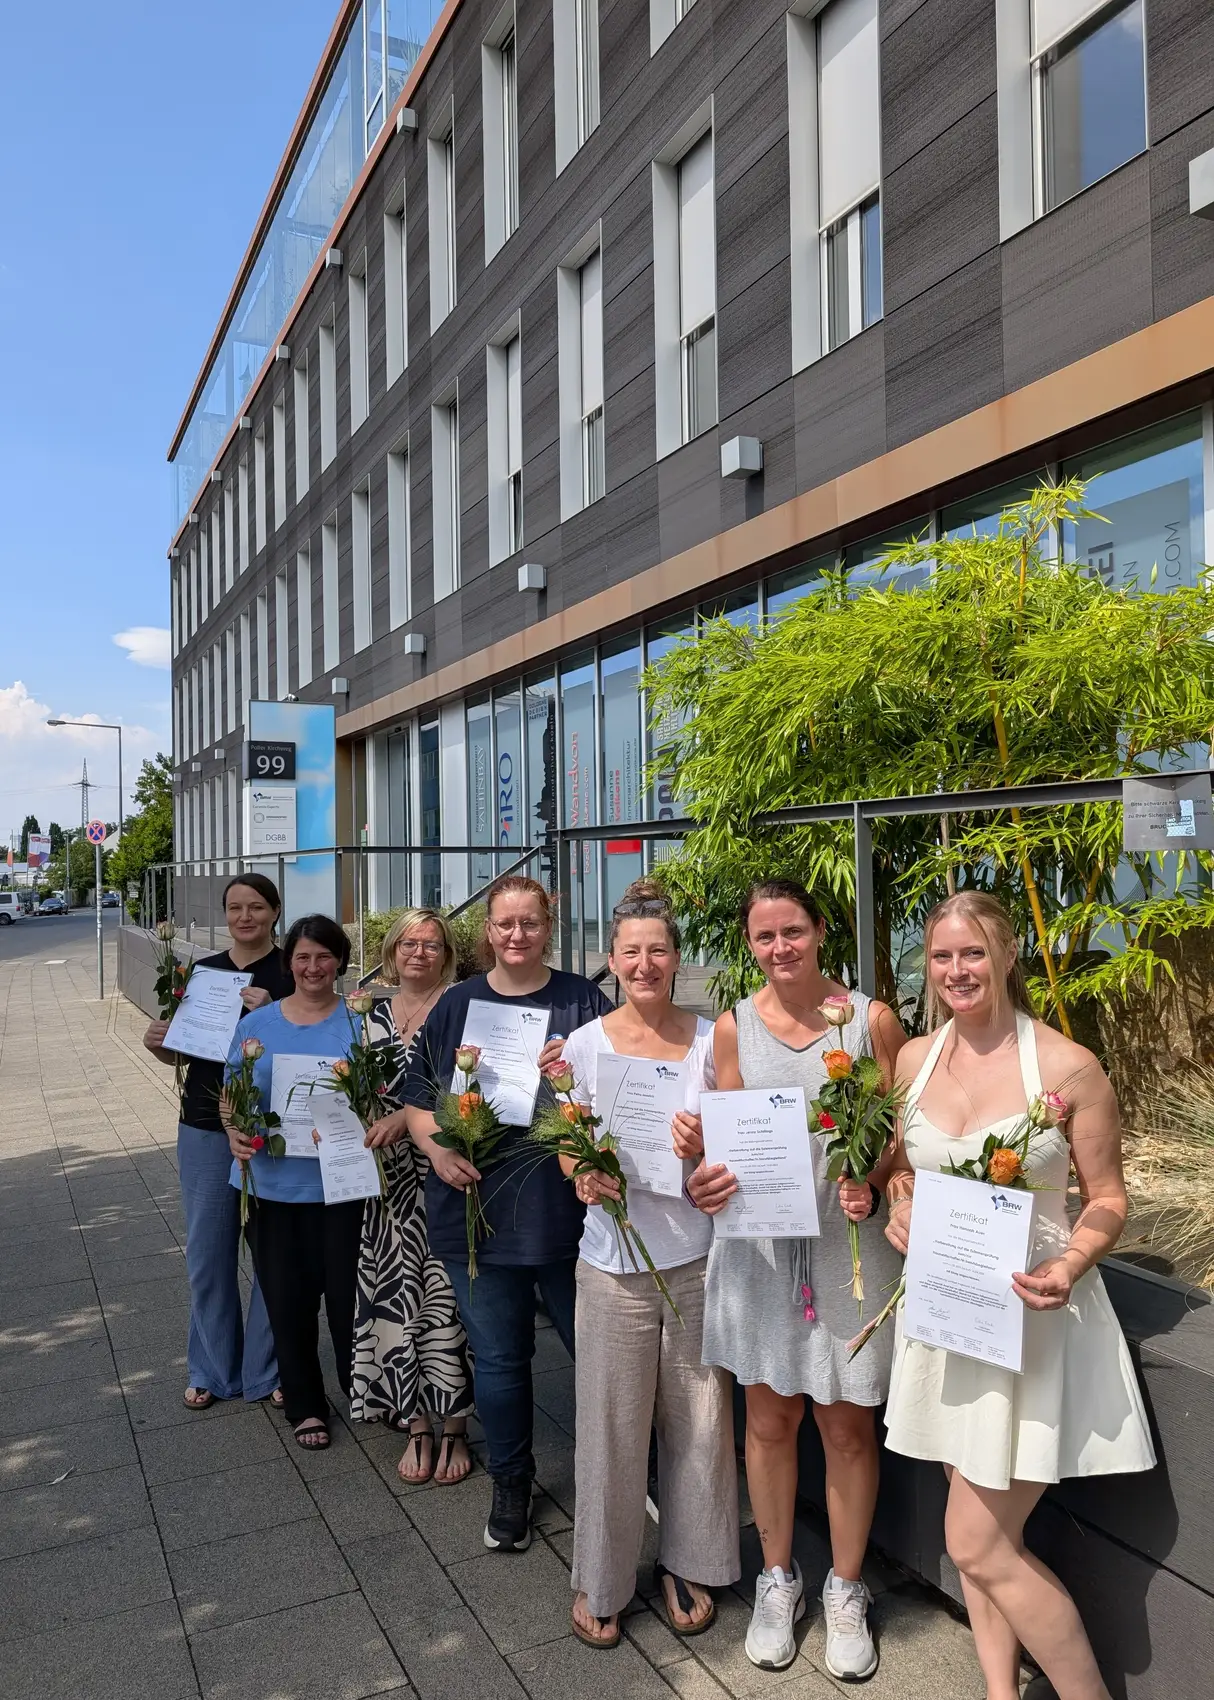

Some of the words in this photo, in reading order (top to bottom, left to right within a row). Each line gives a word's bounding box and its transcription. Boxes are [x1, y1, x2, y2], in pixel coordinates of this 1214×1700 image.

[267, 745, 292, 753] Kirchweg
[256, 755, 285, 775] 99
[265, 834, 287, 842] DGBB
[626, 1080, 655, 1090] Zertifikat
[736, 1117, 771, 1126] Zertifikat
[1002, 1201, 1022, 1210] BRW
[949, 1208, 988, 1226] Zertifikat
